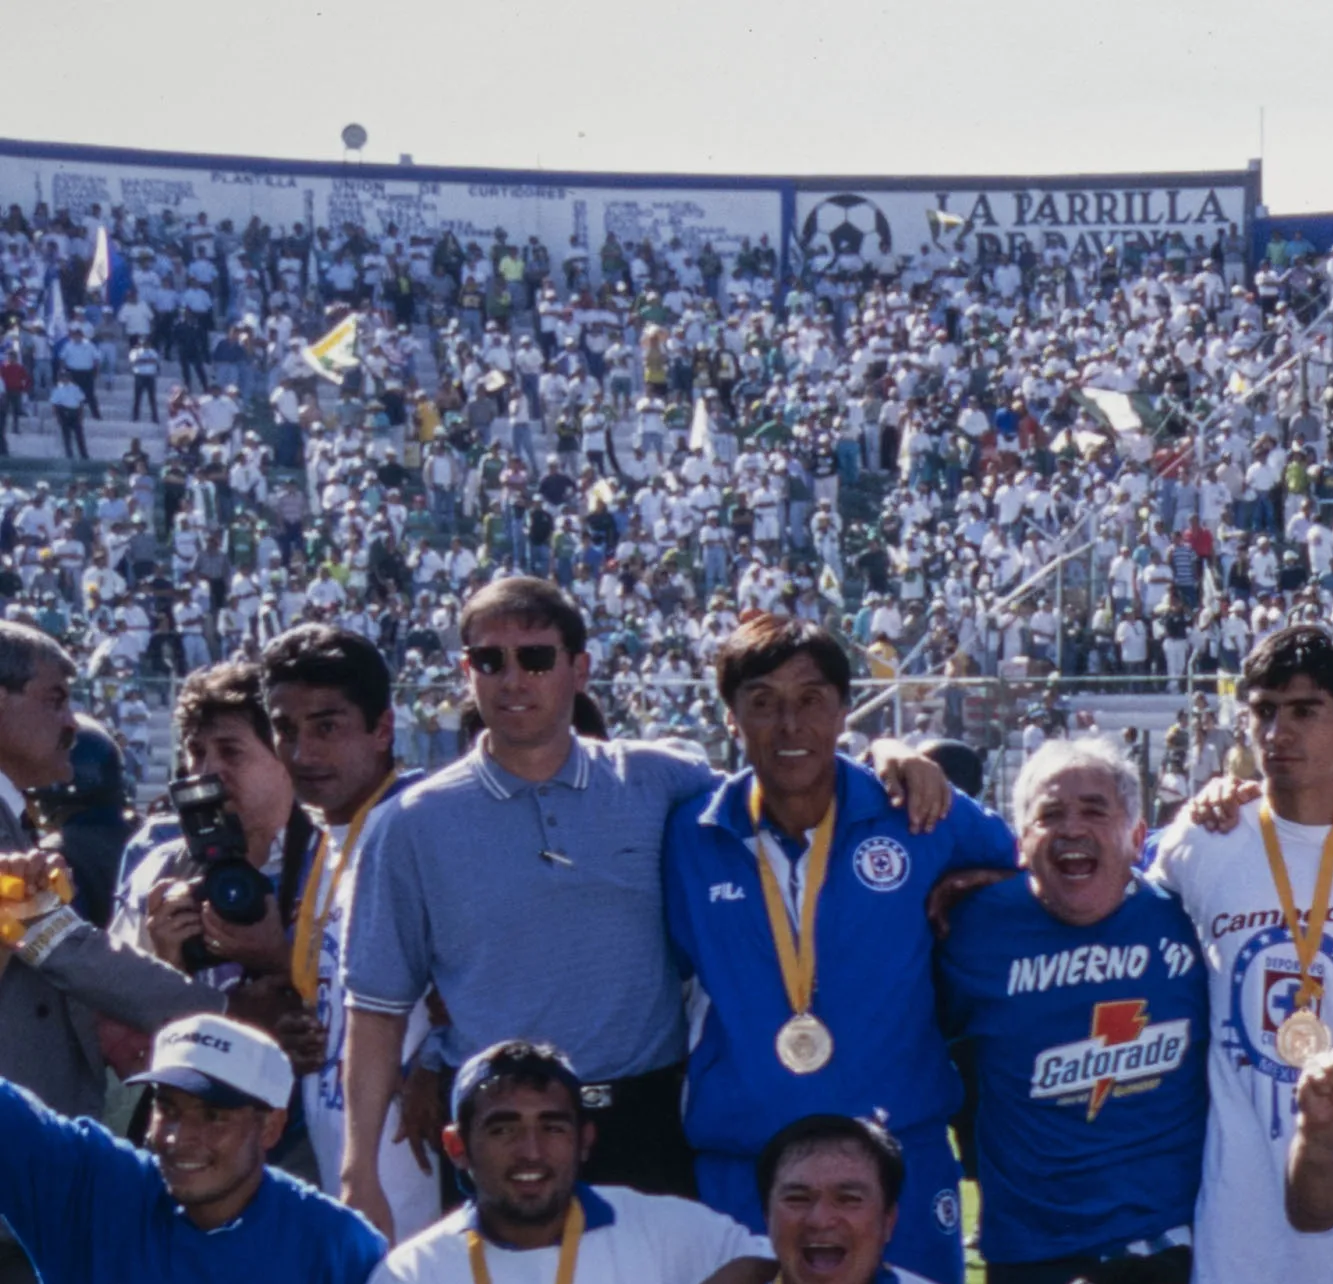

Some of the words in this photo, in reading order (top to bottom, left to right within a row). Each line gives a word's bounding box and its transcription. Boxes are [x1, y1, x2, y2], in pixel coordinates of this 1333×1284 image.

[1014, 188, 1229, 226] PARRILLA
[709, 881, 746, 903] FILA
[1007, 944, 1149, 996] INVIERNO
[1040, 1033, 1182, 1089] Gatorade
